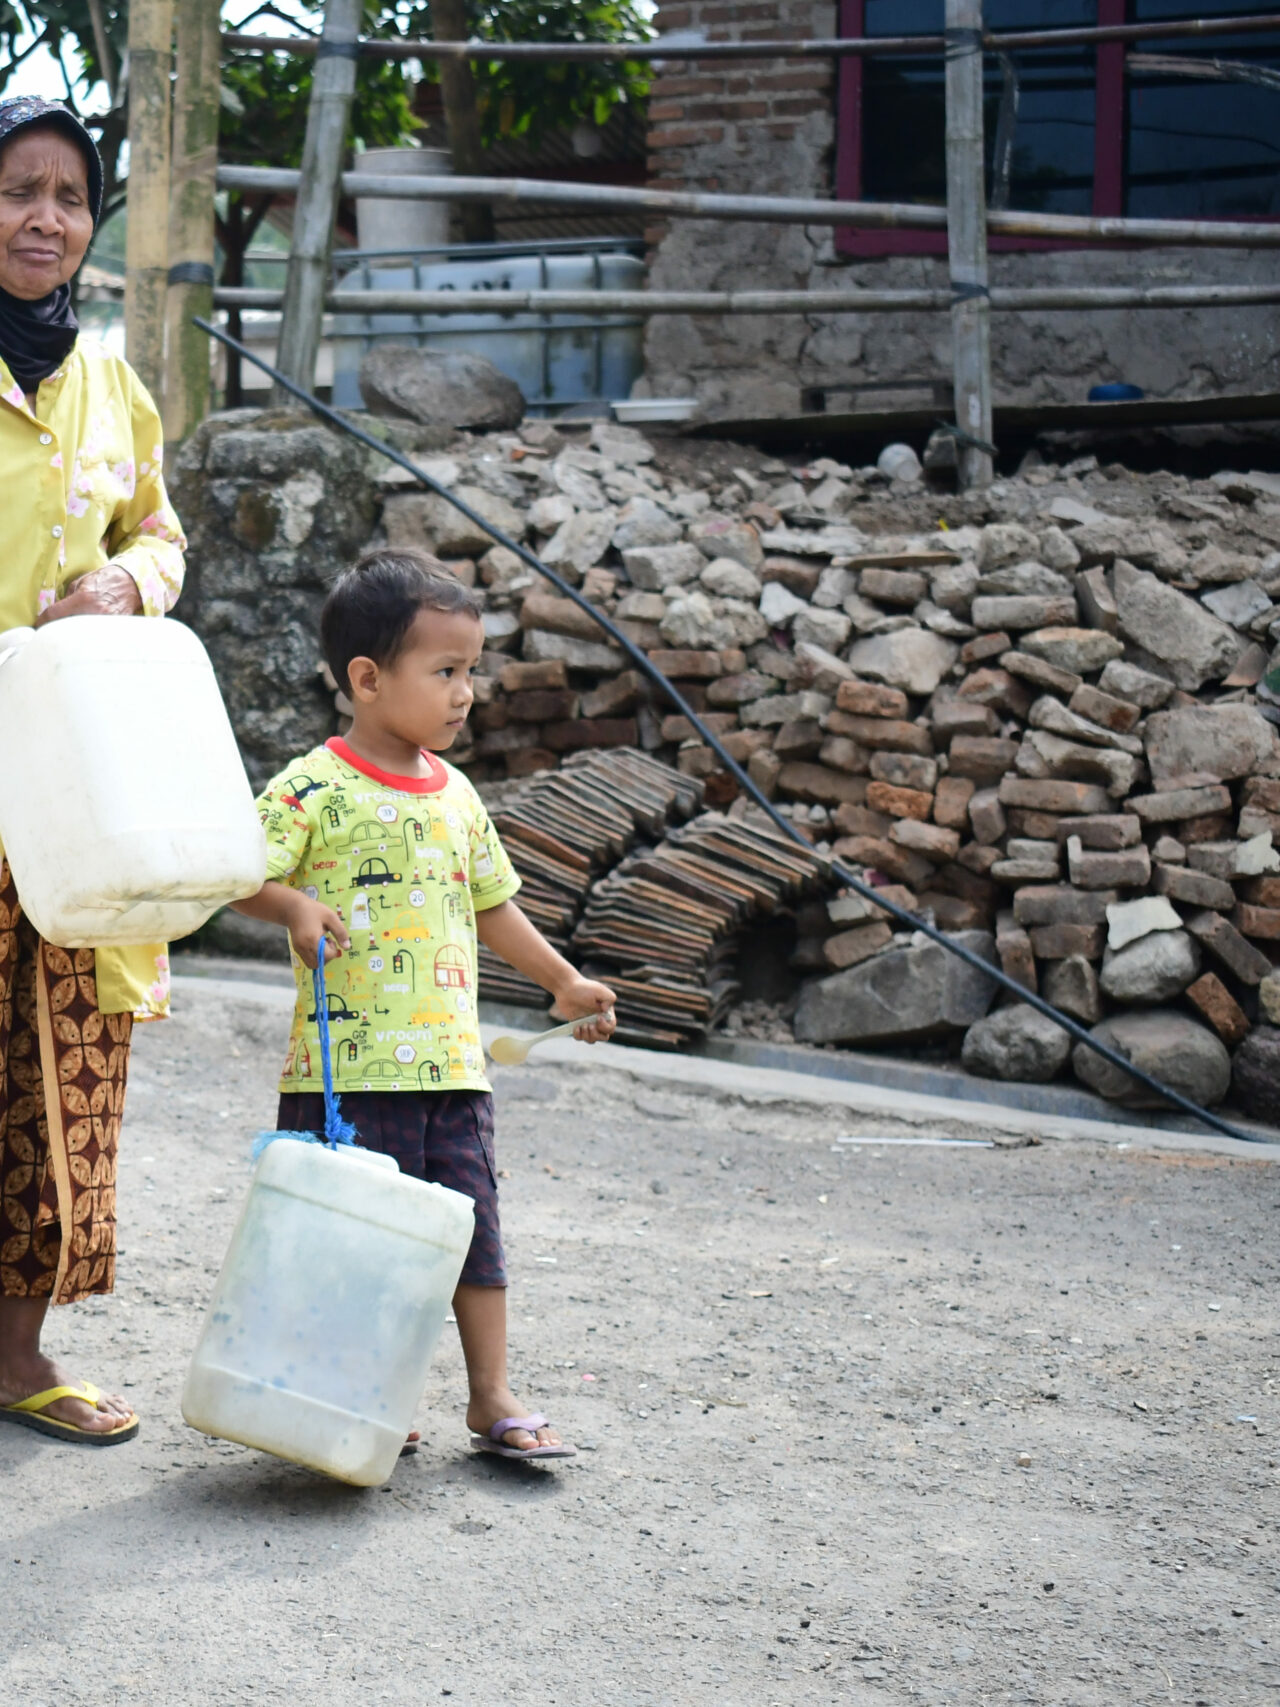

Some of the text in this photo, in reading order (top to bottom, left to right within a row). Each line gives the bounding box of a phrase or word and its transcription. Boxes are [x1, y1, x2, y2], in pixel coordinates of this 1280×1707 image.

[329, 795, 344, 805] GO!
[312, 861, 338, 870] beep
[370, 959, 383, 968] 20
[384, 983, 410, 995] beep
[352, 1030, 368, 1040] GO!
[375, 1030, 433, 1043] vroom
